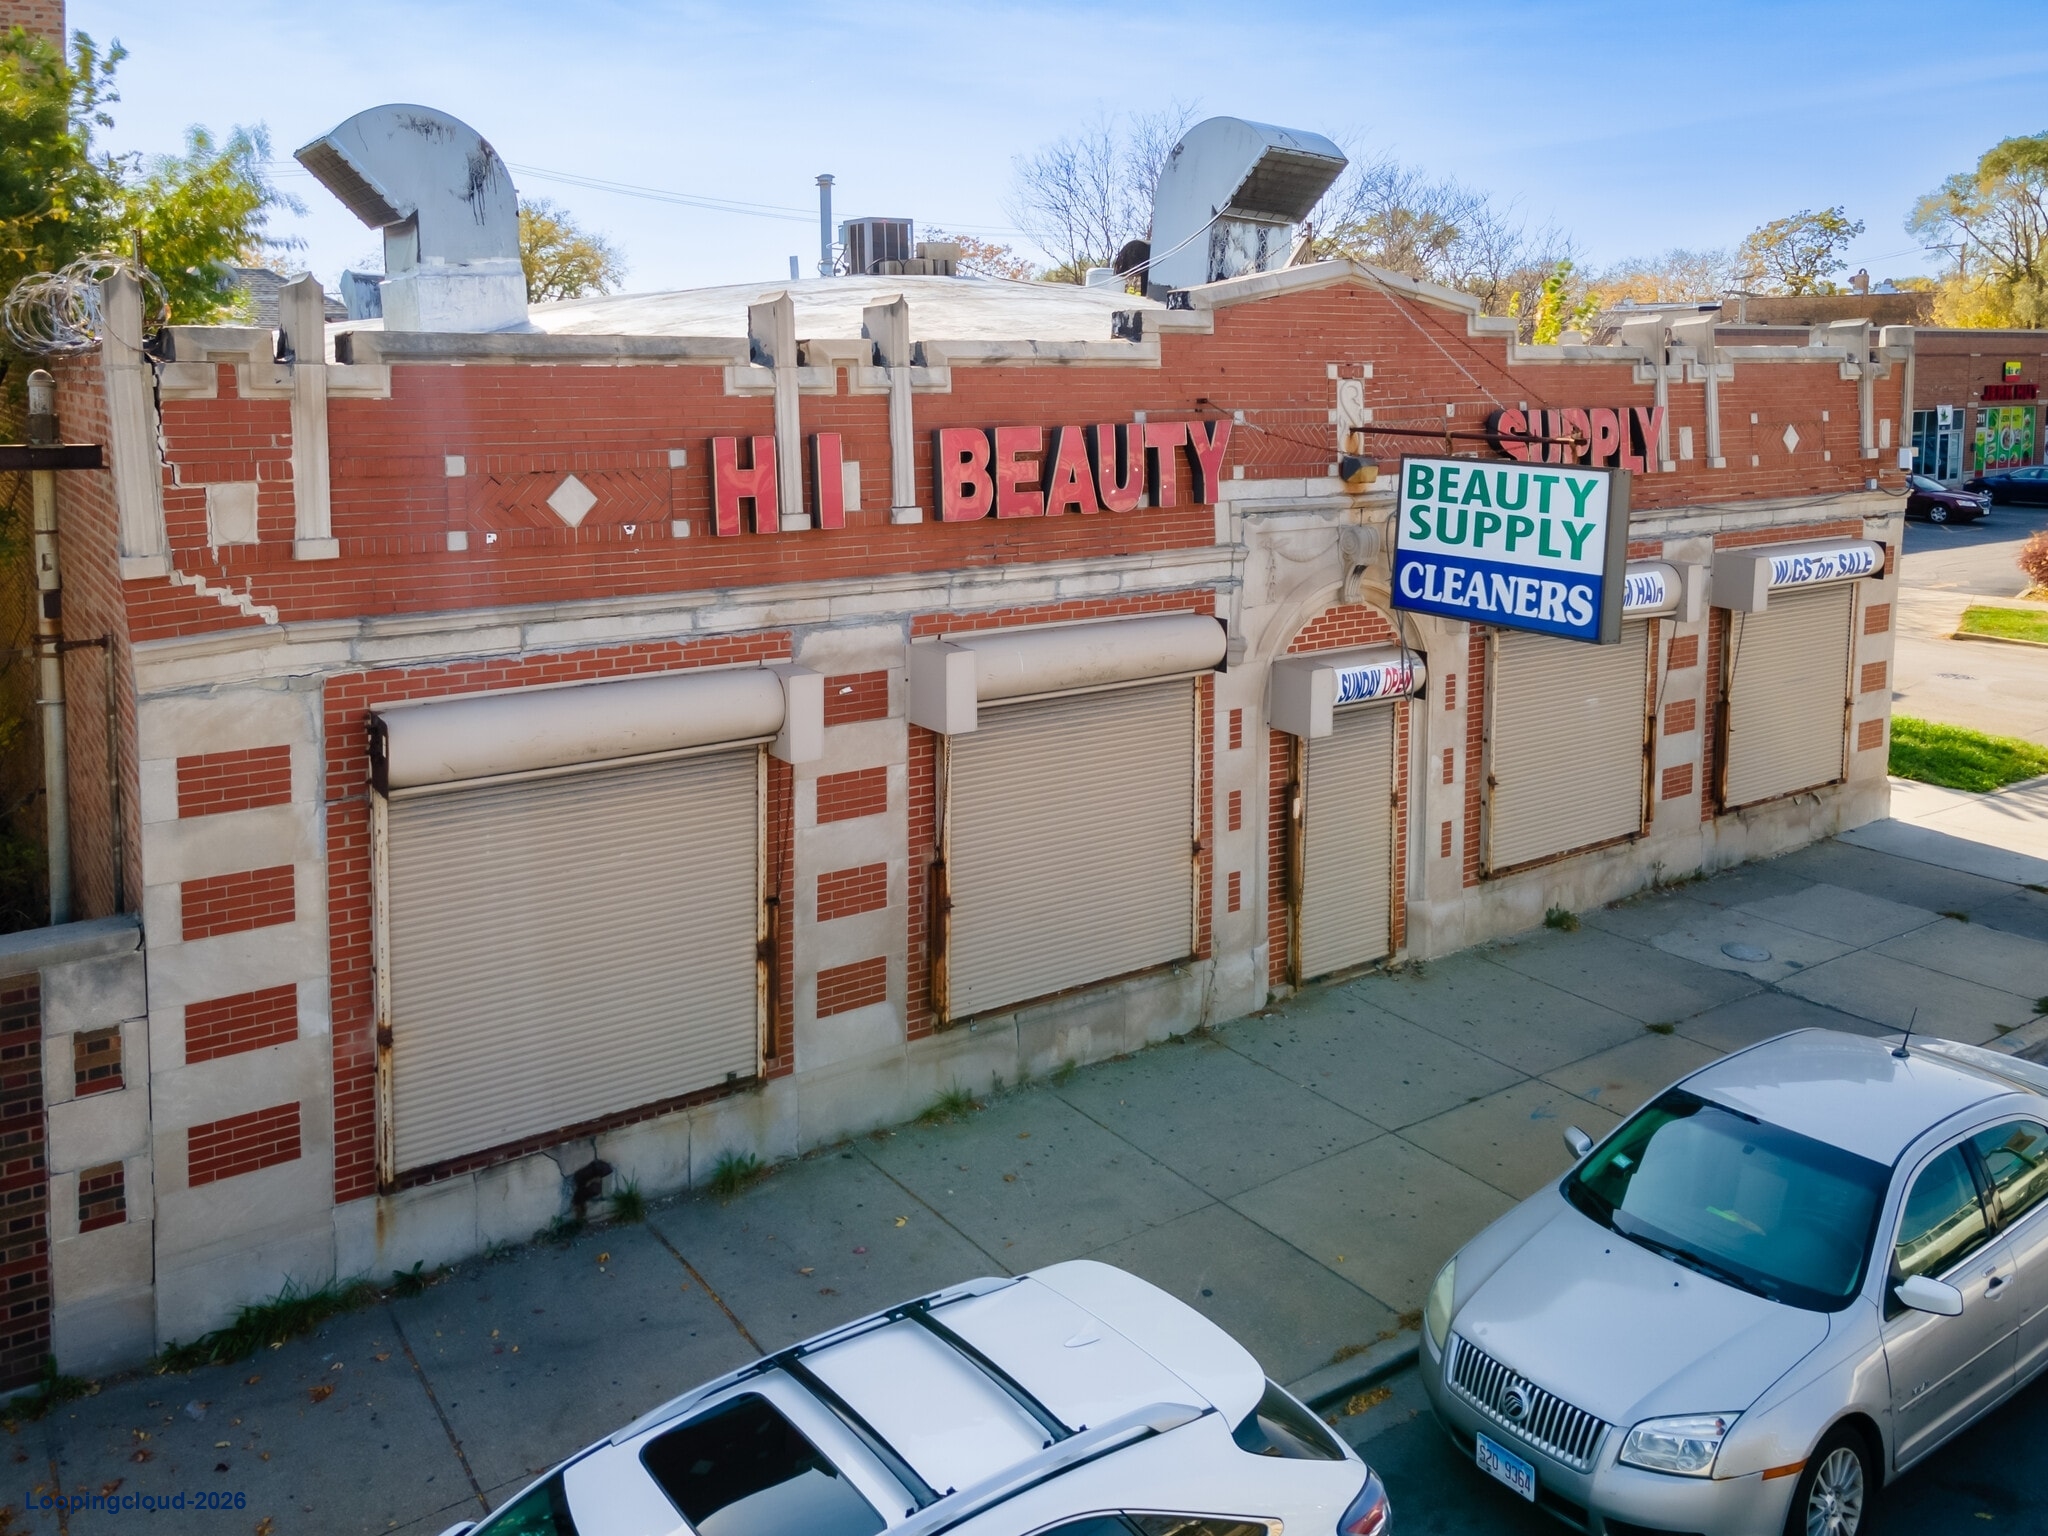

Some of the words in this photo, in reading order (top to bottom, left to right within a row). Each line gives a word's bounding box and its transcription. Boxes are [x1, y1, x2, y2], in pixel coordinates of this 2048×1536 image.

[935, 420, 1232, 522] BEAUTY
[1492, 406, 1664, 475] SUPPLY
[1407, 464, 1599, 518] BEAUTY
[1409, 504, 1597, 561] SUPPLY
[1400, 561, 1594, 627] CLEANERS
[1774, 558, 1813, 585] WIGS
[1836, 551, 1873, 578] SALE
[1338, 669, 1381, 703] SUNDAY
[1382, 665, 1413, 696] OPEN
[1480, 1444, 1498, 1471] S20
[1505, 1460, 1530, 1492] 9364
